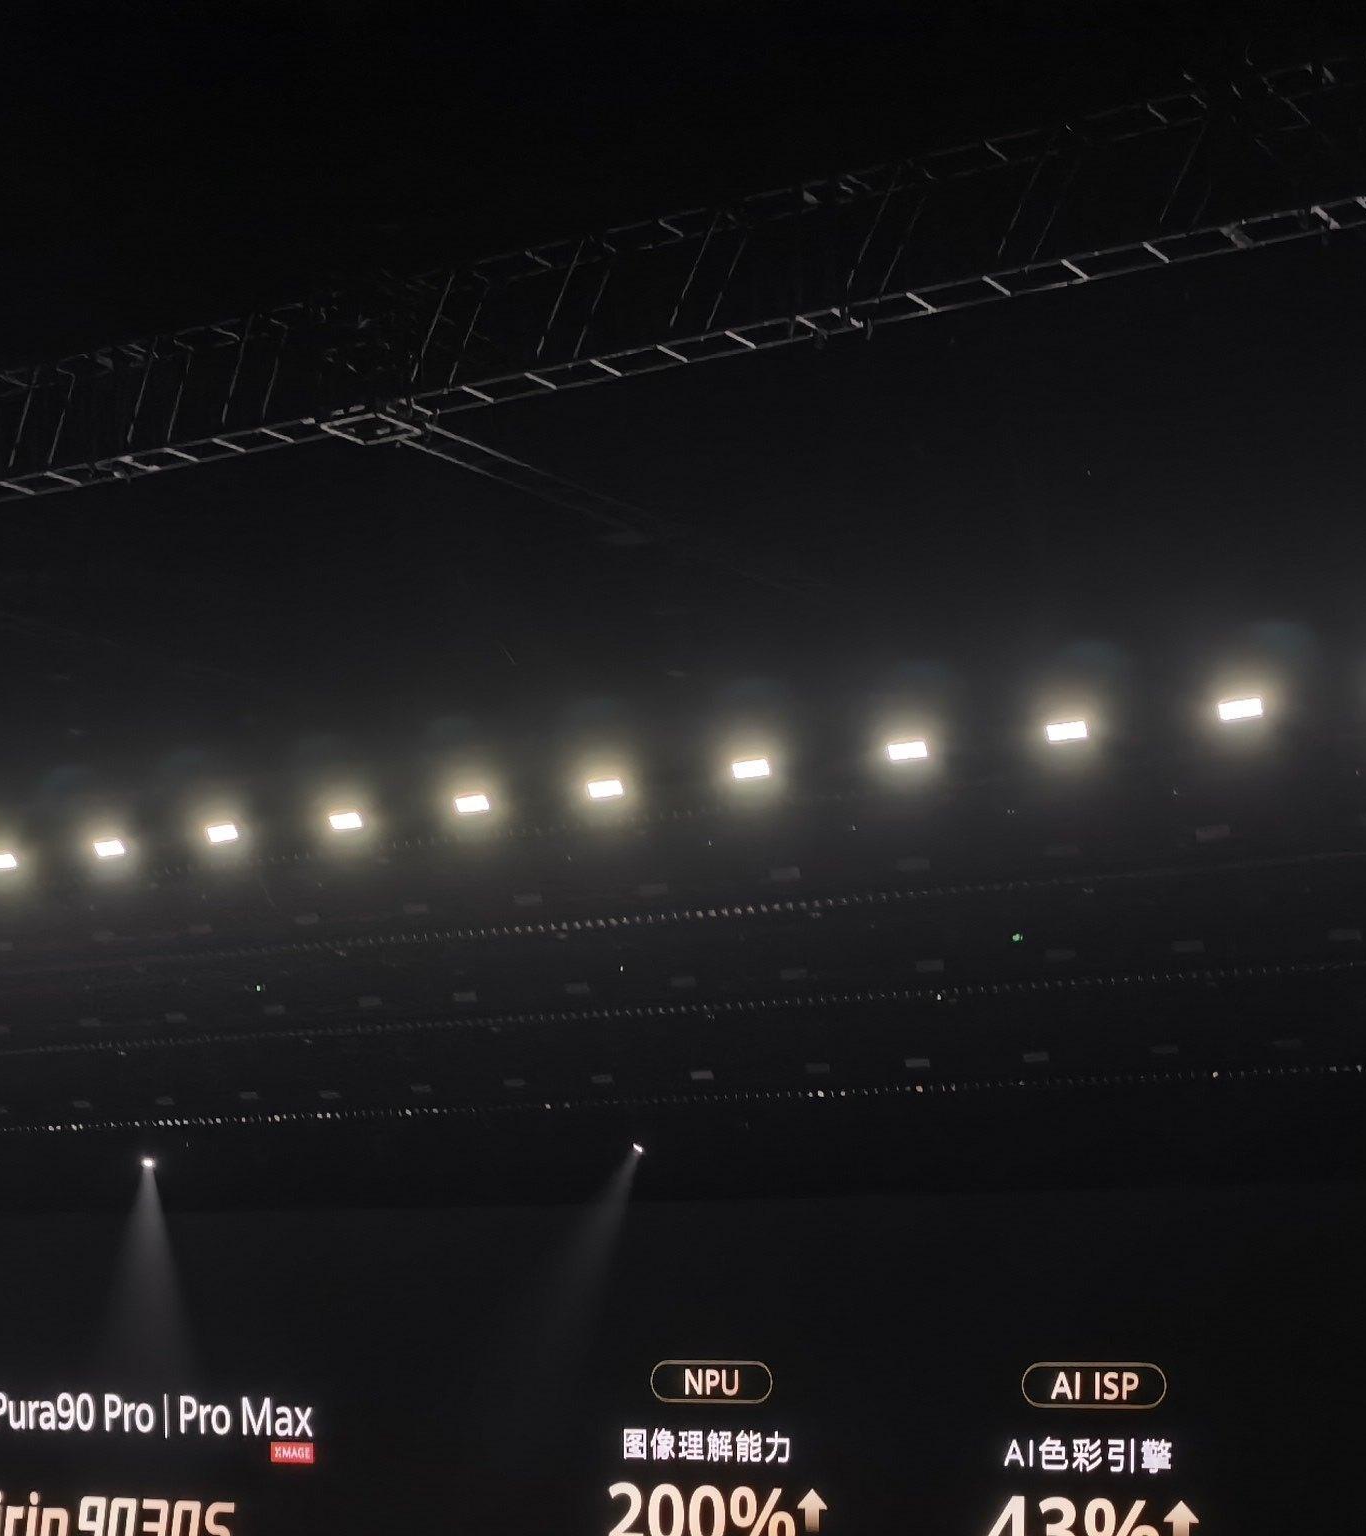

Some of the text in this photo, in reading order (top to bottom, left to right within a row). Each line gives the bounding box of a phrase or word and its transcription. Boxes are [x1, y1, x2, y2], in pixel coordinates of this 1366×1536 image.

[685, 1369, 739, 1396] NPU
[1051, 1372, 1139, 1400] AI ISP
[104, 1393, 155, 1434] Pro
[179, 1394, 231, 1436] Pro
[241, 1396, 313, 1437] Max
[274, 1446, 311, 1460] XMAGE
[623, 1428, 791, 1464] 图像理解能力
[1004, 1437, 1173, 1475] AI色彩引擎
